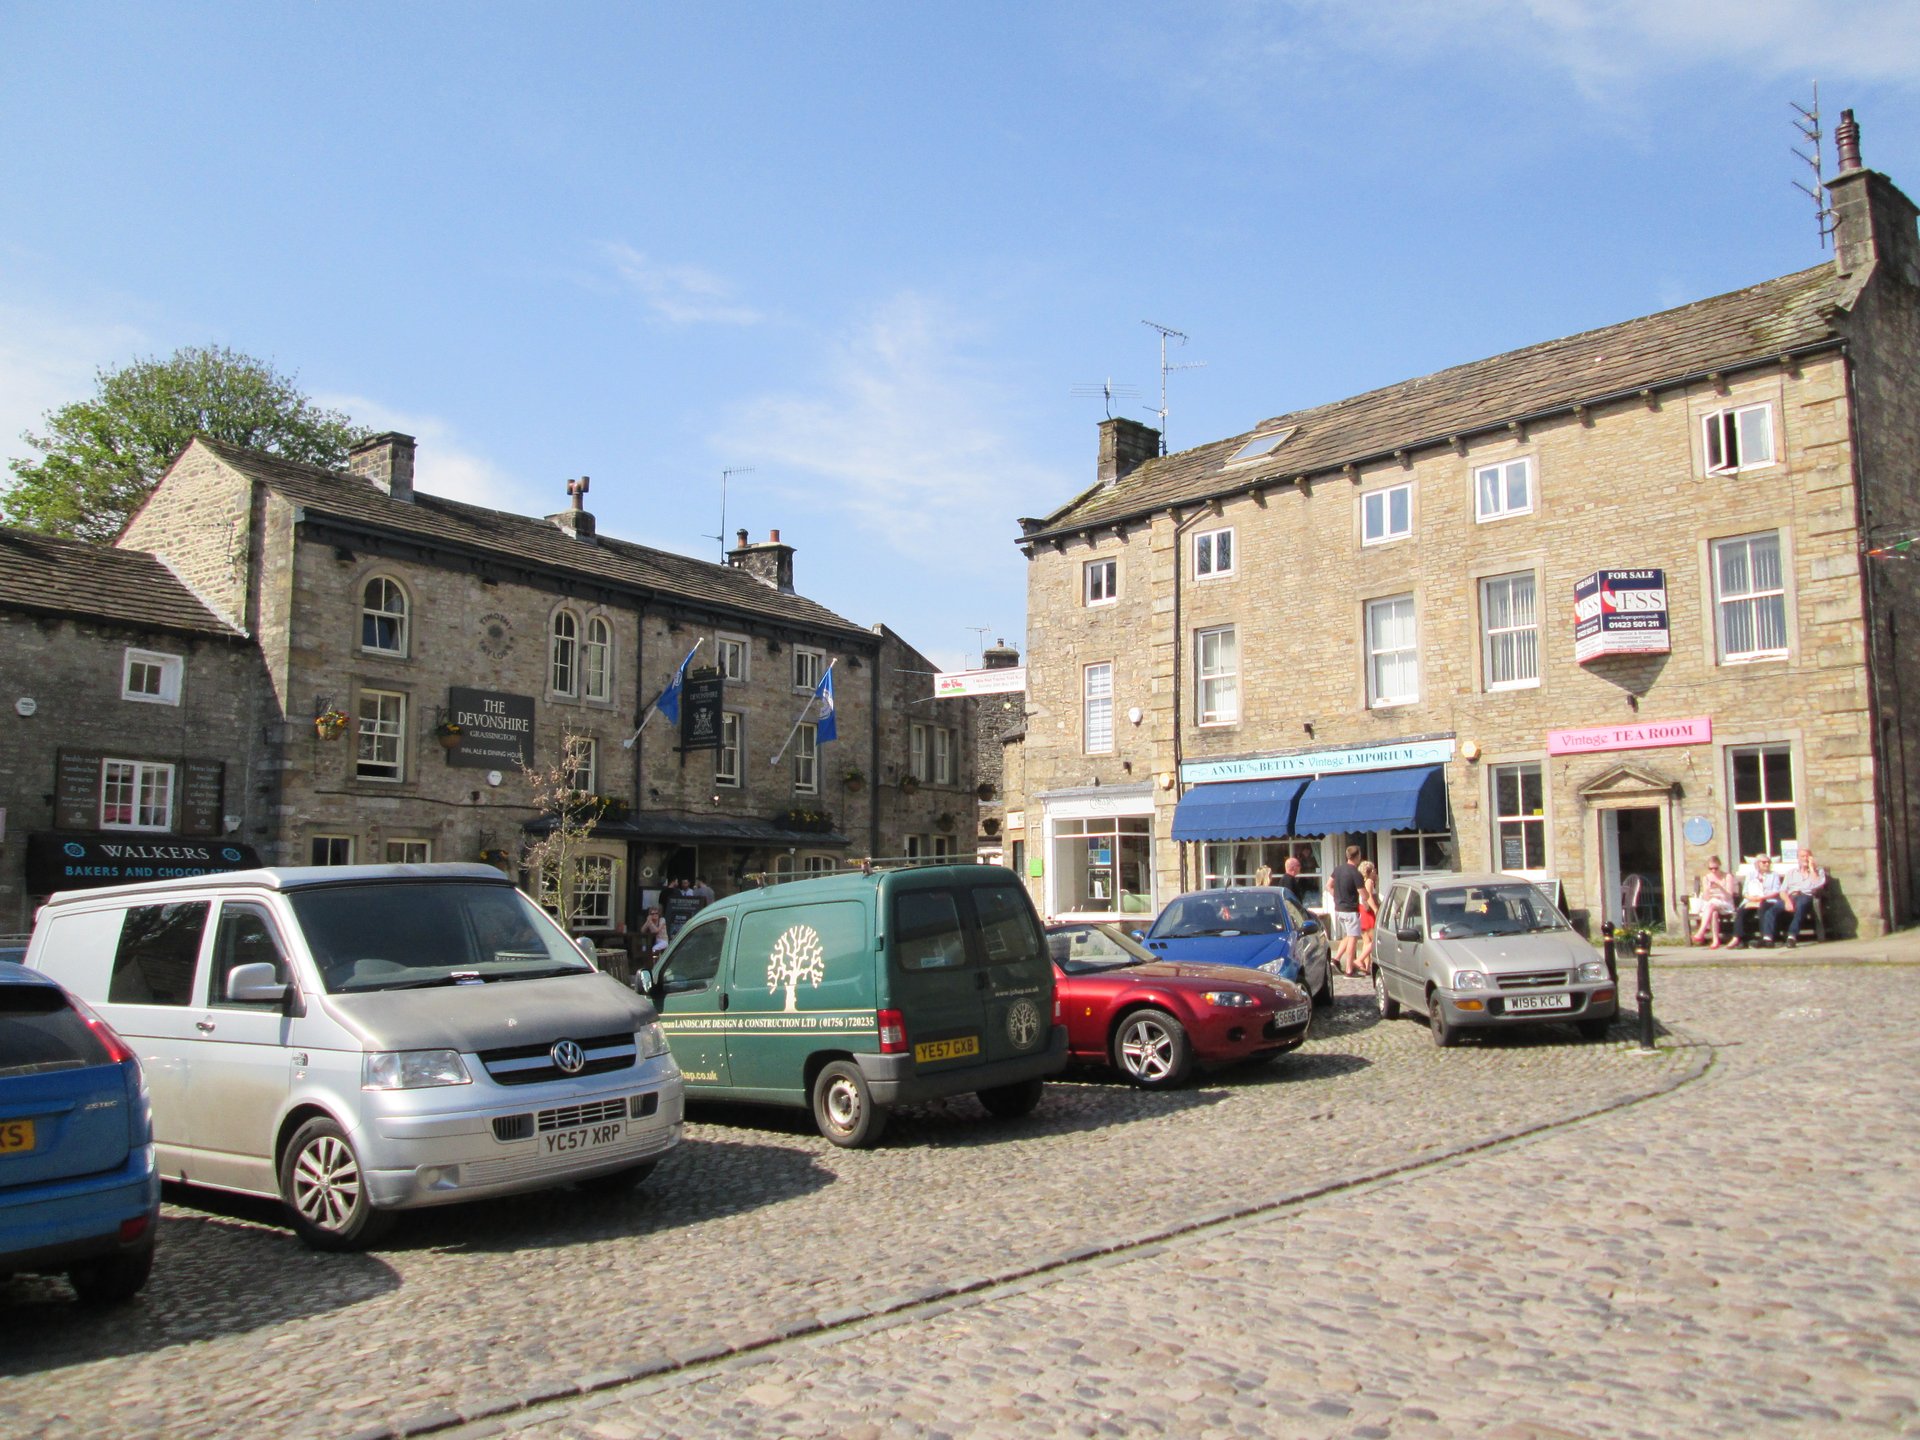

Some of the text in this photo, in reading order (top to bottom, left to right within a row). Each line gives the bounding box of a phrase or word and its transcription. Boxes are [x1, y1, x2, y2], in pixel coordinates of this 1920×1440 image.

[1608, 571, 1654, 580] FOR SALE
[1621, 591, 1662, 610] FSS
[1608, 621, 1632, 629] 01423
[483, 699, 506, 714] THE
[457, 711, 529, 732] DEVONSHIRE
[469, 730, 517, 741] GRASSINGTON
[1561, 725, 1693, 747] Vintage TEA ROOM
[1211, 764, 1246, 775] ANNIE
[1259, 758, 1305, 771] BETTY'S
[1308, 757, 1345, 768] Vintage
[1347, 749, 1413, 764] EMPORIUM
[100, 844, 210, 860] WALKERS
[65, 866, 119, 876] BAKERS
[125, 867, 153, 876] AND
[1511, 994, 1564, 1009] W196 KCK
[675, 1019, 712, 1029] LANDSCAPE
[712, 1019, 737, 1028] DESIGN
[737, 1019, 744, 1028] &
[744, 1018, 800, 1028] CONSTRUCTION
[801, 1017, 817, 1028] LTD
[919, 1042, 951, 1059] YE57
[546, 1123, 620, 1153] YC57 XRP
